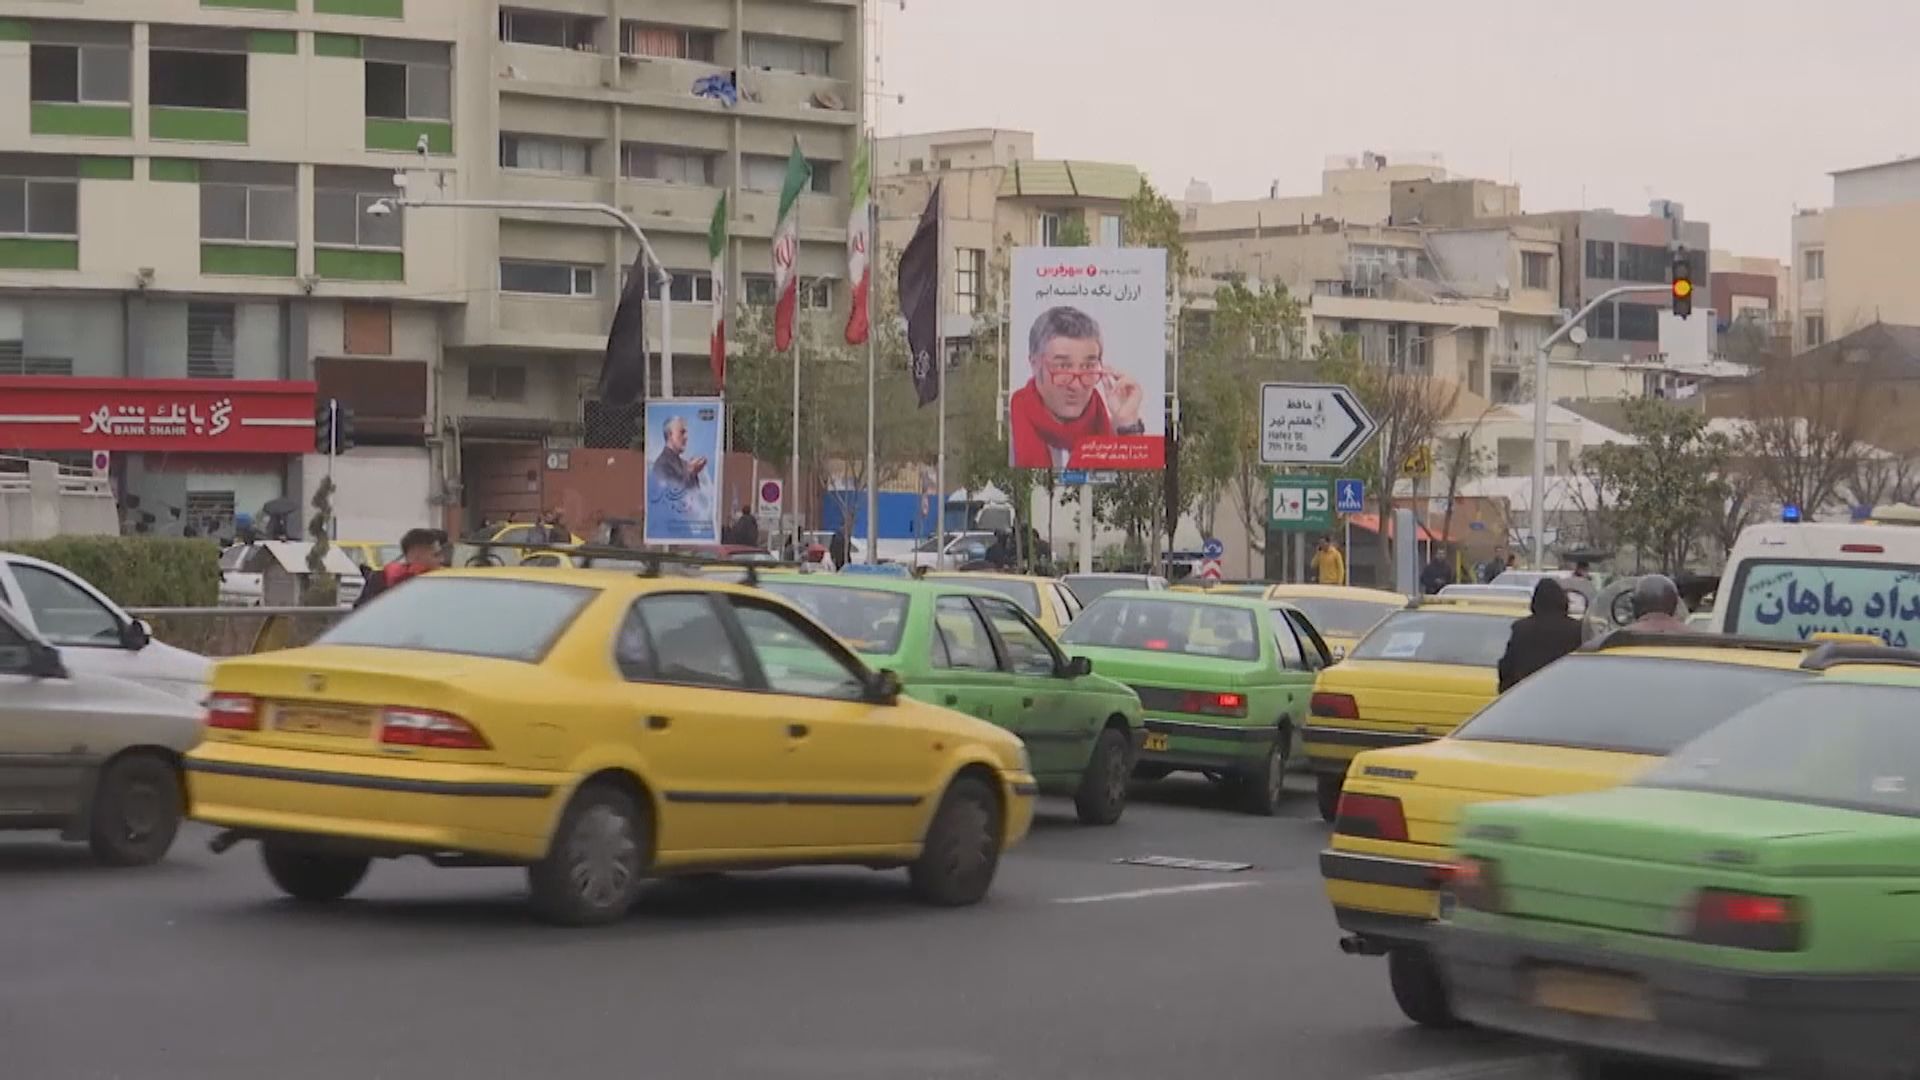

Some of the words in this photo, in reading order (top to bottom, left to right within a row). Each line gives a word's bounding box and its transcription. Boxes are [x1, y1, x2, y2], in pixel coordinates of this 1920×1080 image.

[1287, 399, 1312, 410] حافظ
[82, 404, 145, 434] شهر
[1269, 415, 1285, 428] تیر
[1288, 416, 1312, 430] هفتم
[114, 425, 145, 435] BANK
[150, 425, 187, 436] SHAHR
[1755, 579, 1853, 625] ماهان
